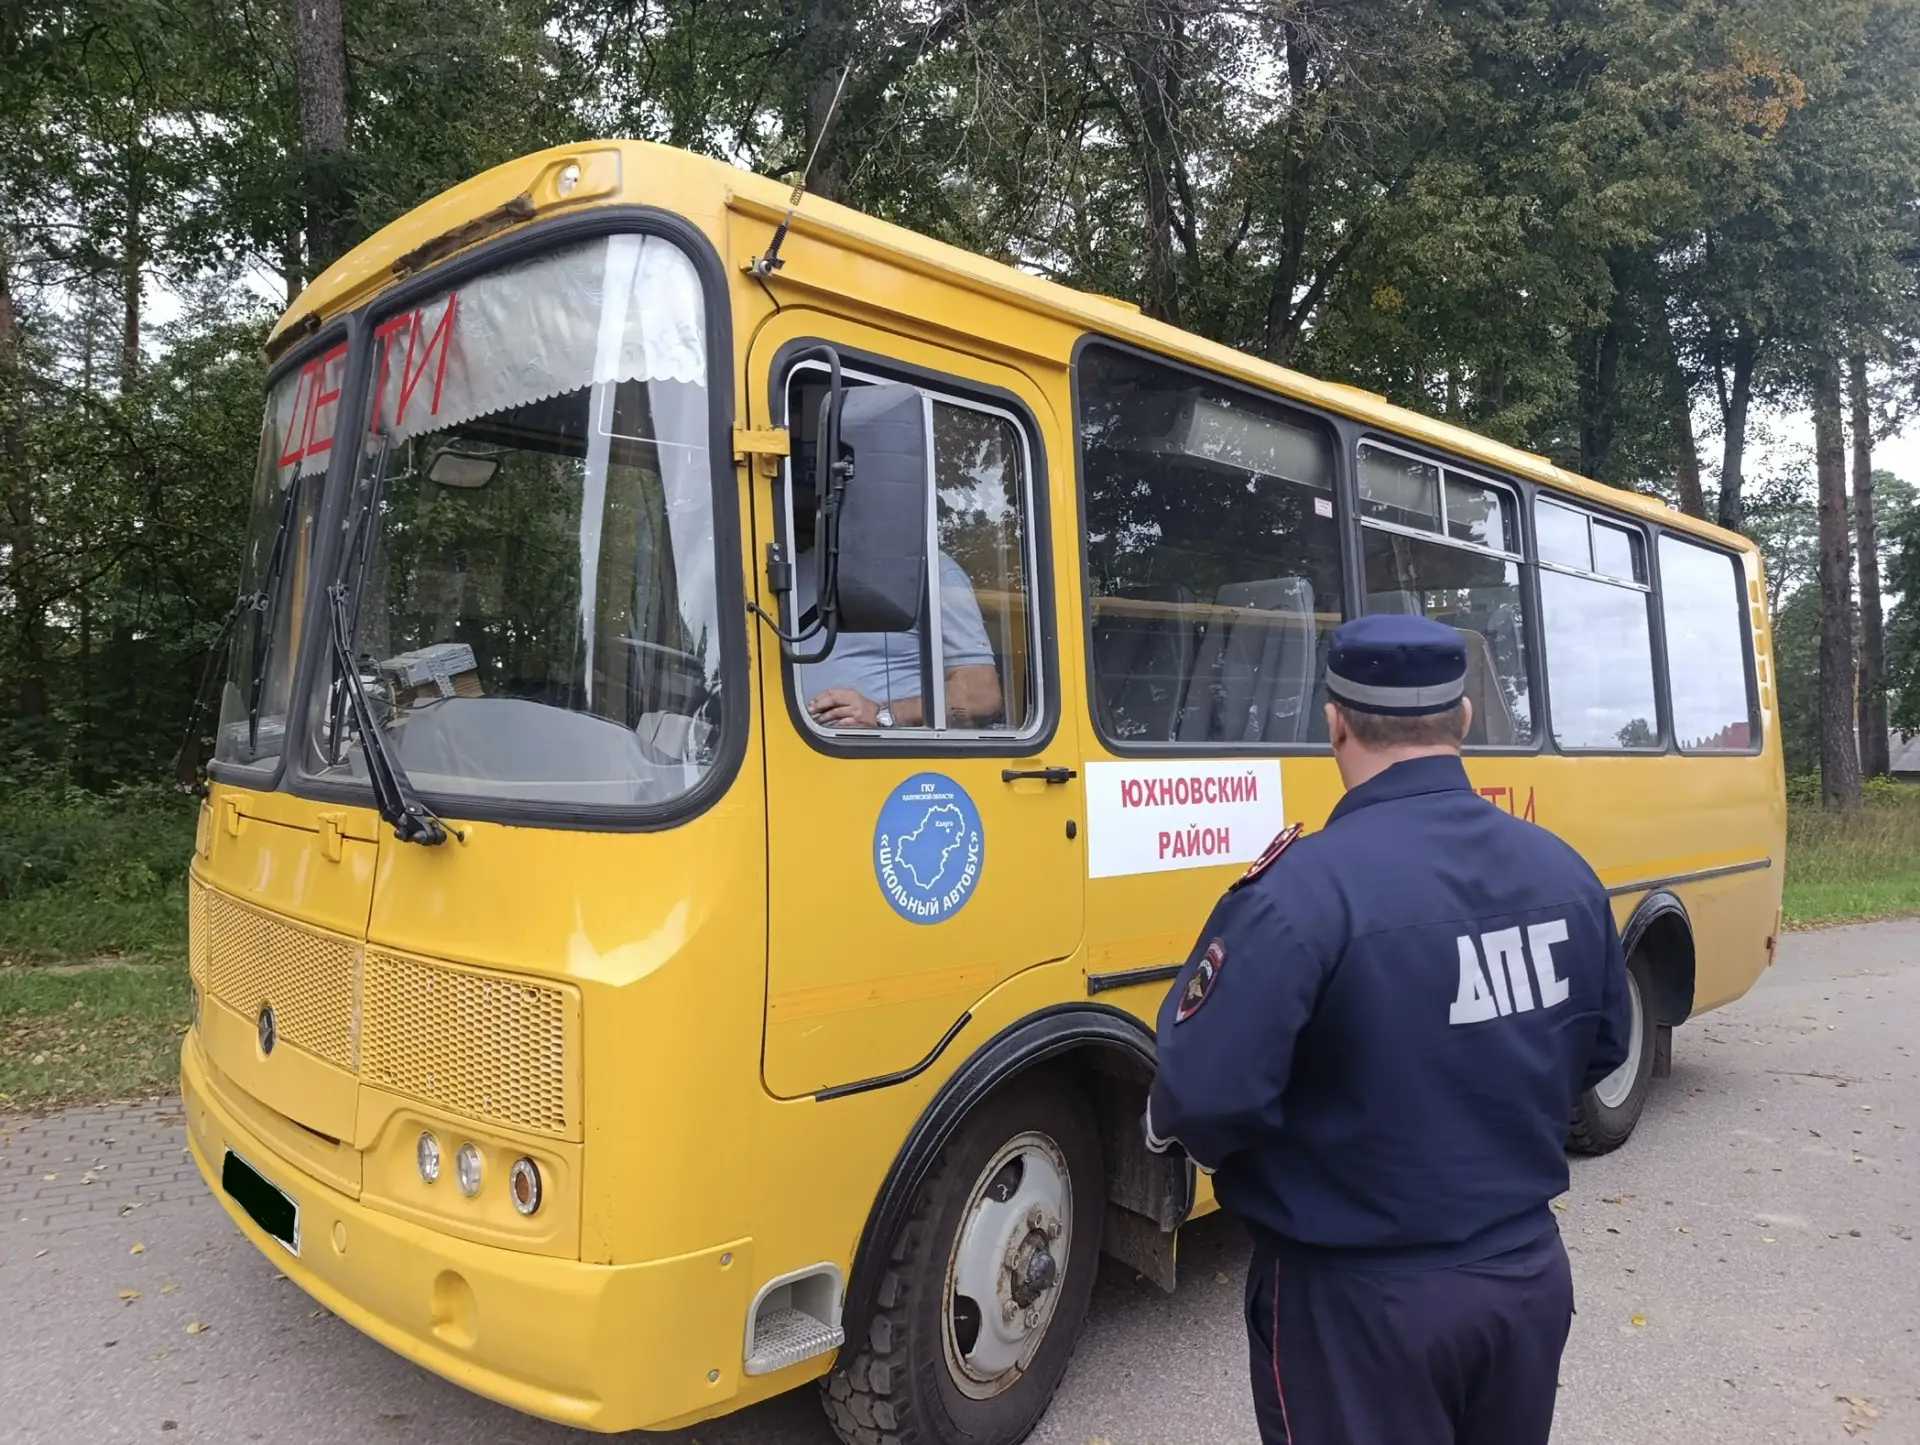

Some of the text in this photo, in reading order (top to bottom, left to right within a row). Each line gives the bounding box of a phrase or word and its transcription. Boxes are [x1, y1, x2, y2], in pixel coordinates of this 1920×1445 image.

[921, 783, 935, 792] ГКУ
[1121, 770, 1258, 808] ЮХНОВСКИЙ
[935, 820, 954, 828] Калуга
[1158, 823, 1230, 859] РАЙОН
[880, 831, 979, 916] «ШКОЛЬНЫЙ АВТОБУС»
[1449, 918, 1570, 1025] ДПС
